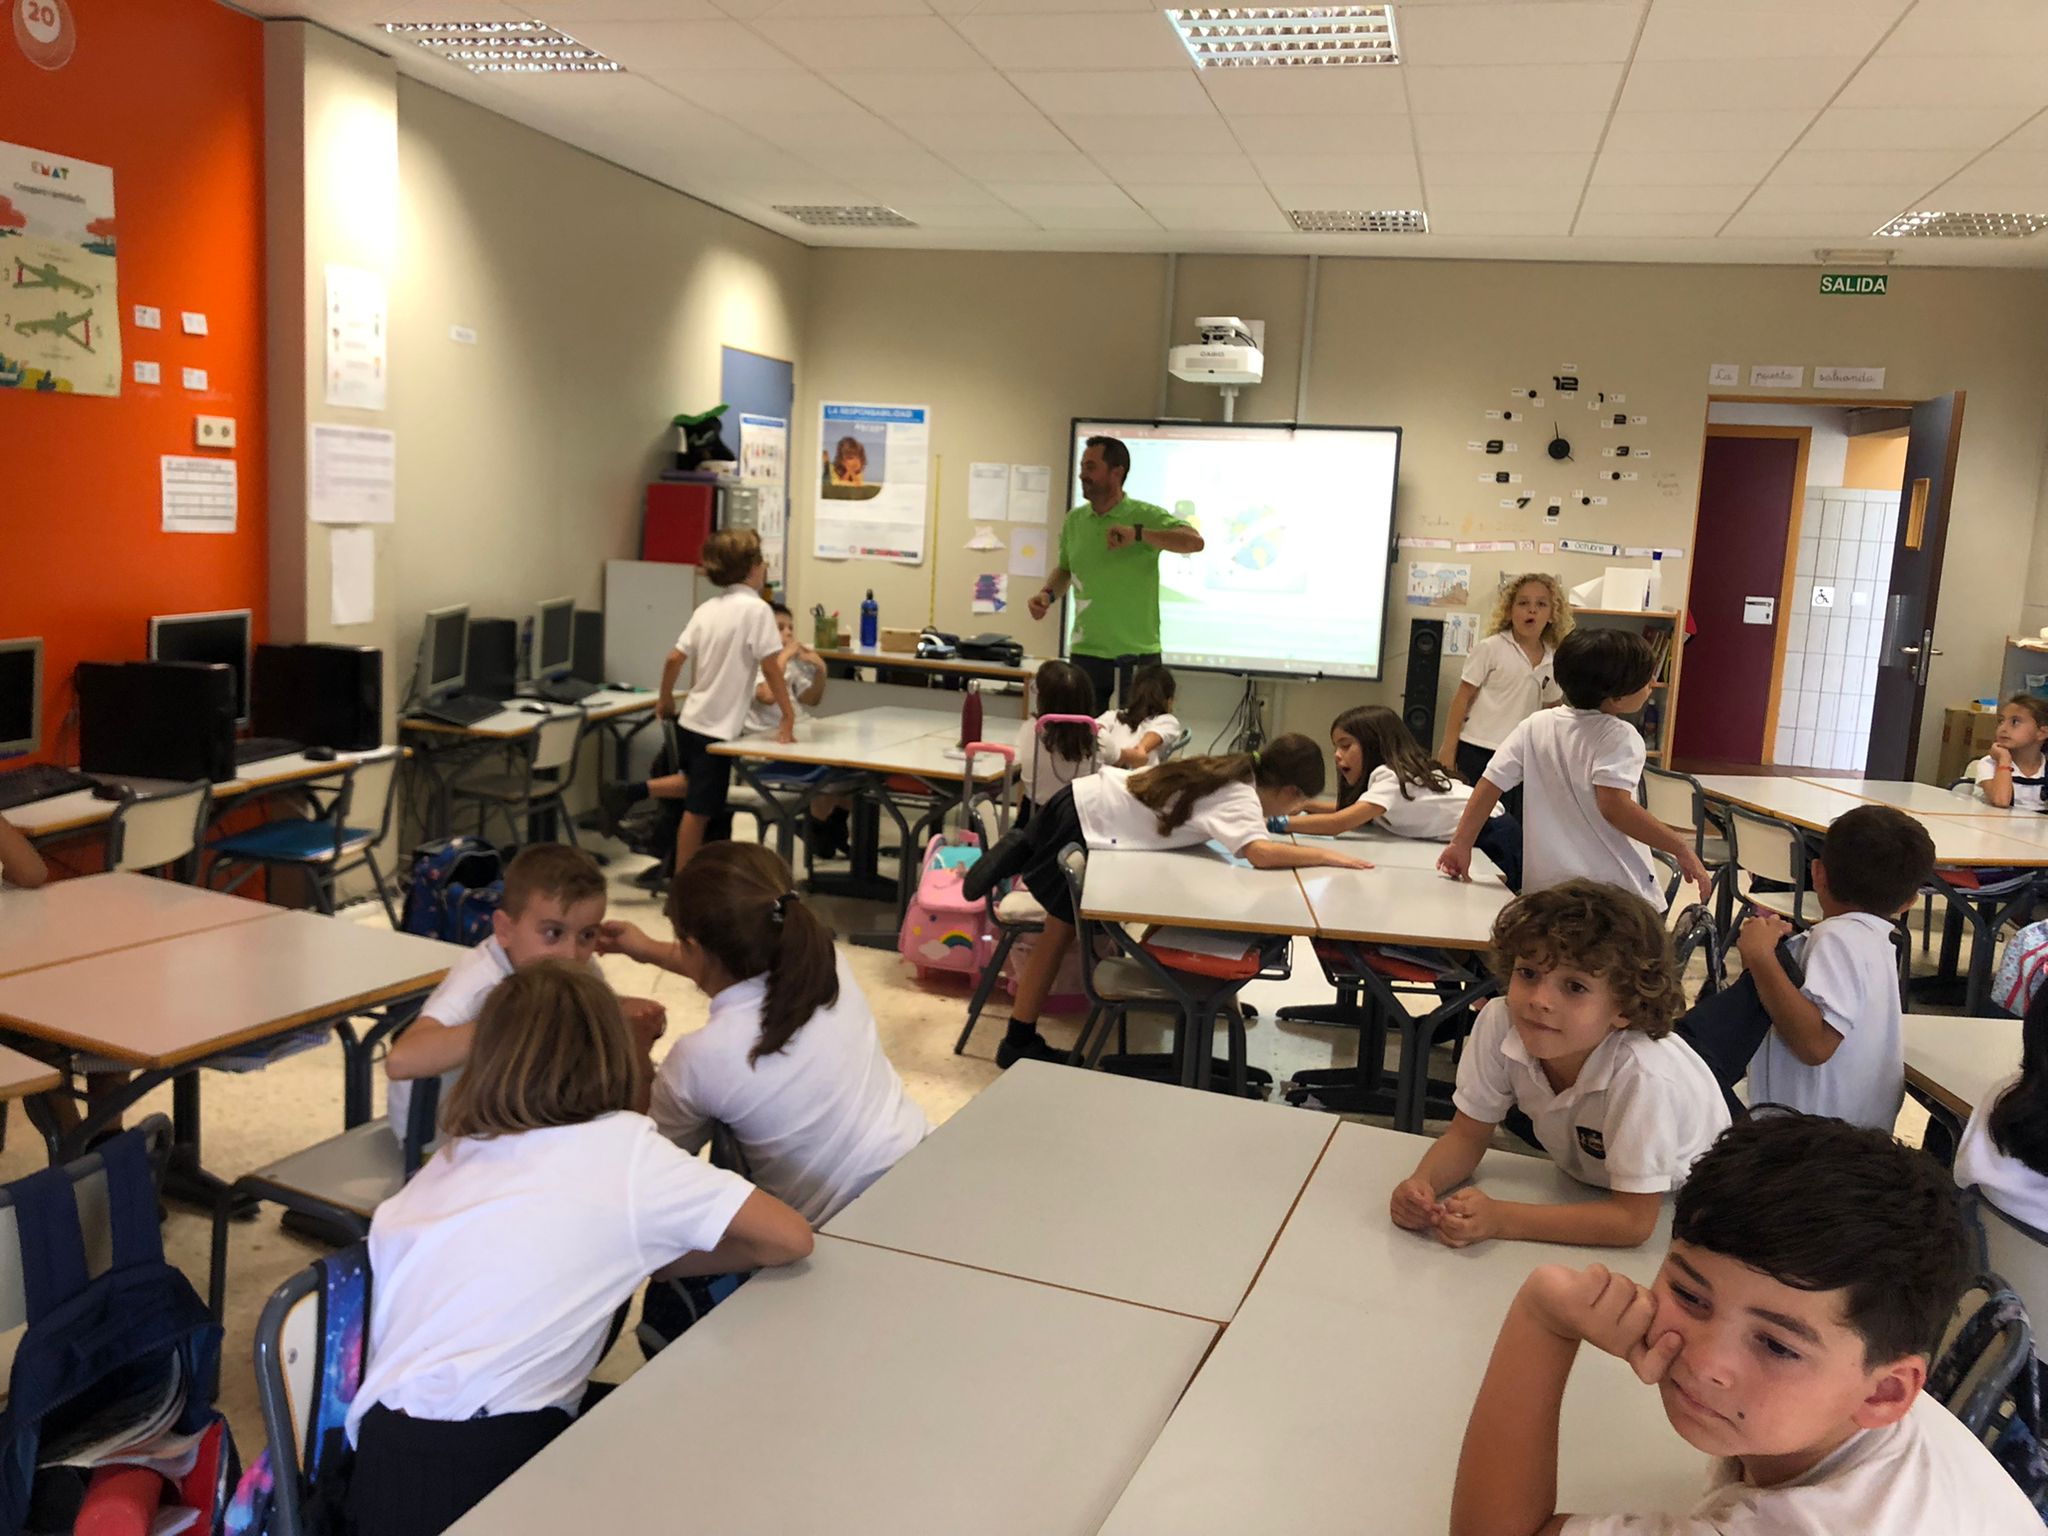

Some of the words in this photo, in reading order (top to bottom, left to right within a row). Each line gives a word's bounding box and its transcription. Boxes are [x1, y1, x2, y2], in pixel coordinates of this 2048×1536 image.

[29, 1, 55, 27] 20
[31, 161, 69, 180] EMAT
[1821, 276, 1885, 292] SALIDA
[1553, 376, 1579, 391] 12
[1598, 392, 1604, 402] 1
[1613, 414, 1627, 425] 2
[1486, 440, 1503, 454] 9
[1616, 446, 1630, 456] 3
[1496, 472, 1510, 483] 8
[1517, 498, 1531, 509] 7
